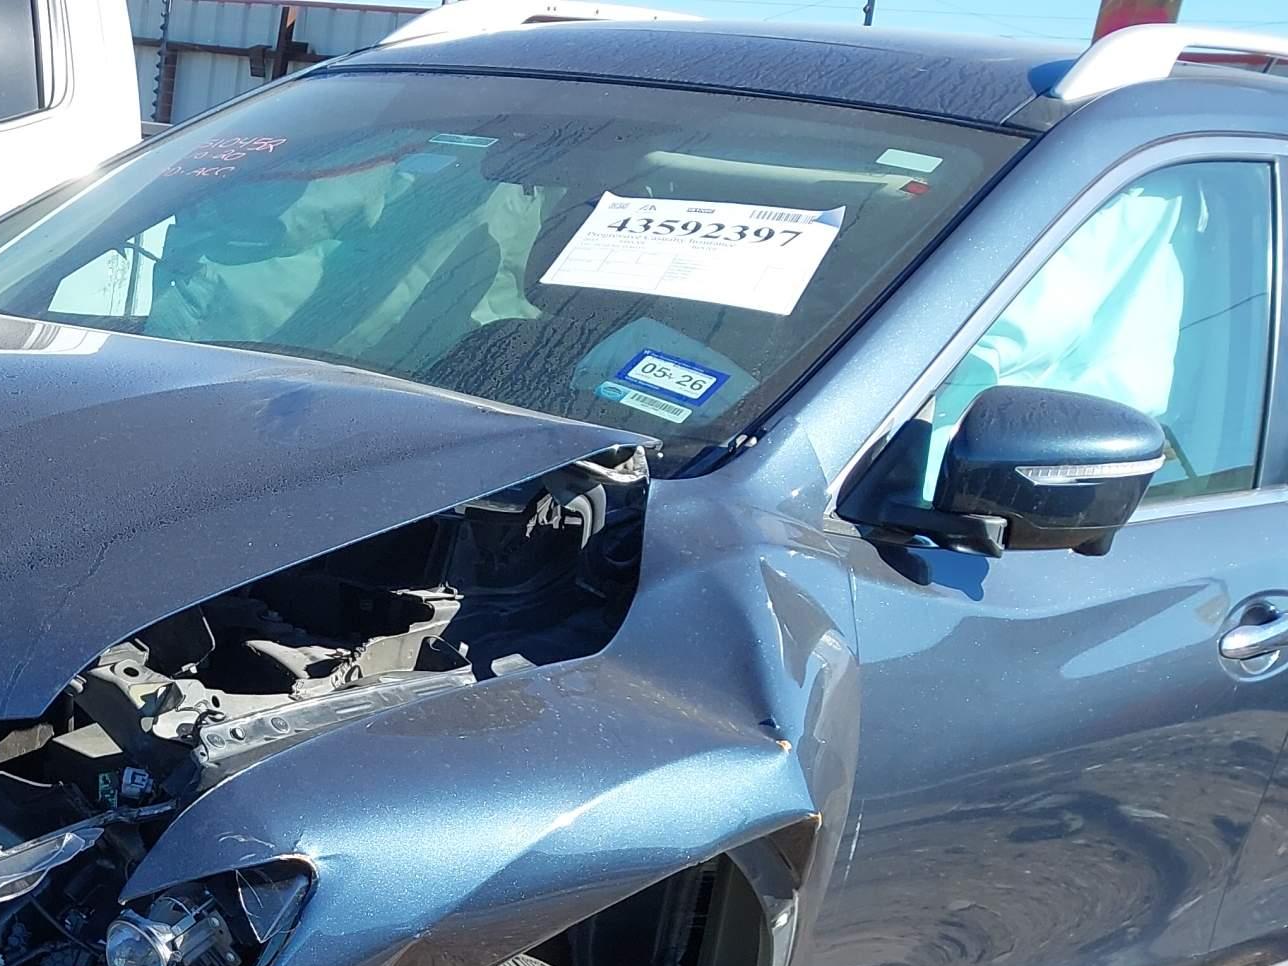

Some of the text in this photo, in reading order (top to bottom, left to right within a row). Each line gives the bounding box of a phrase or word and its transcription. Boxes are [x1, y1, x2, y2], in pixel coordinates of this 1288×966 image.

[608, 216, 803, 247] 43592397
[641, 362, 672, 378] 05
[675, 374, 708, 391] 26
